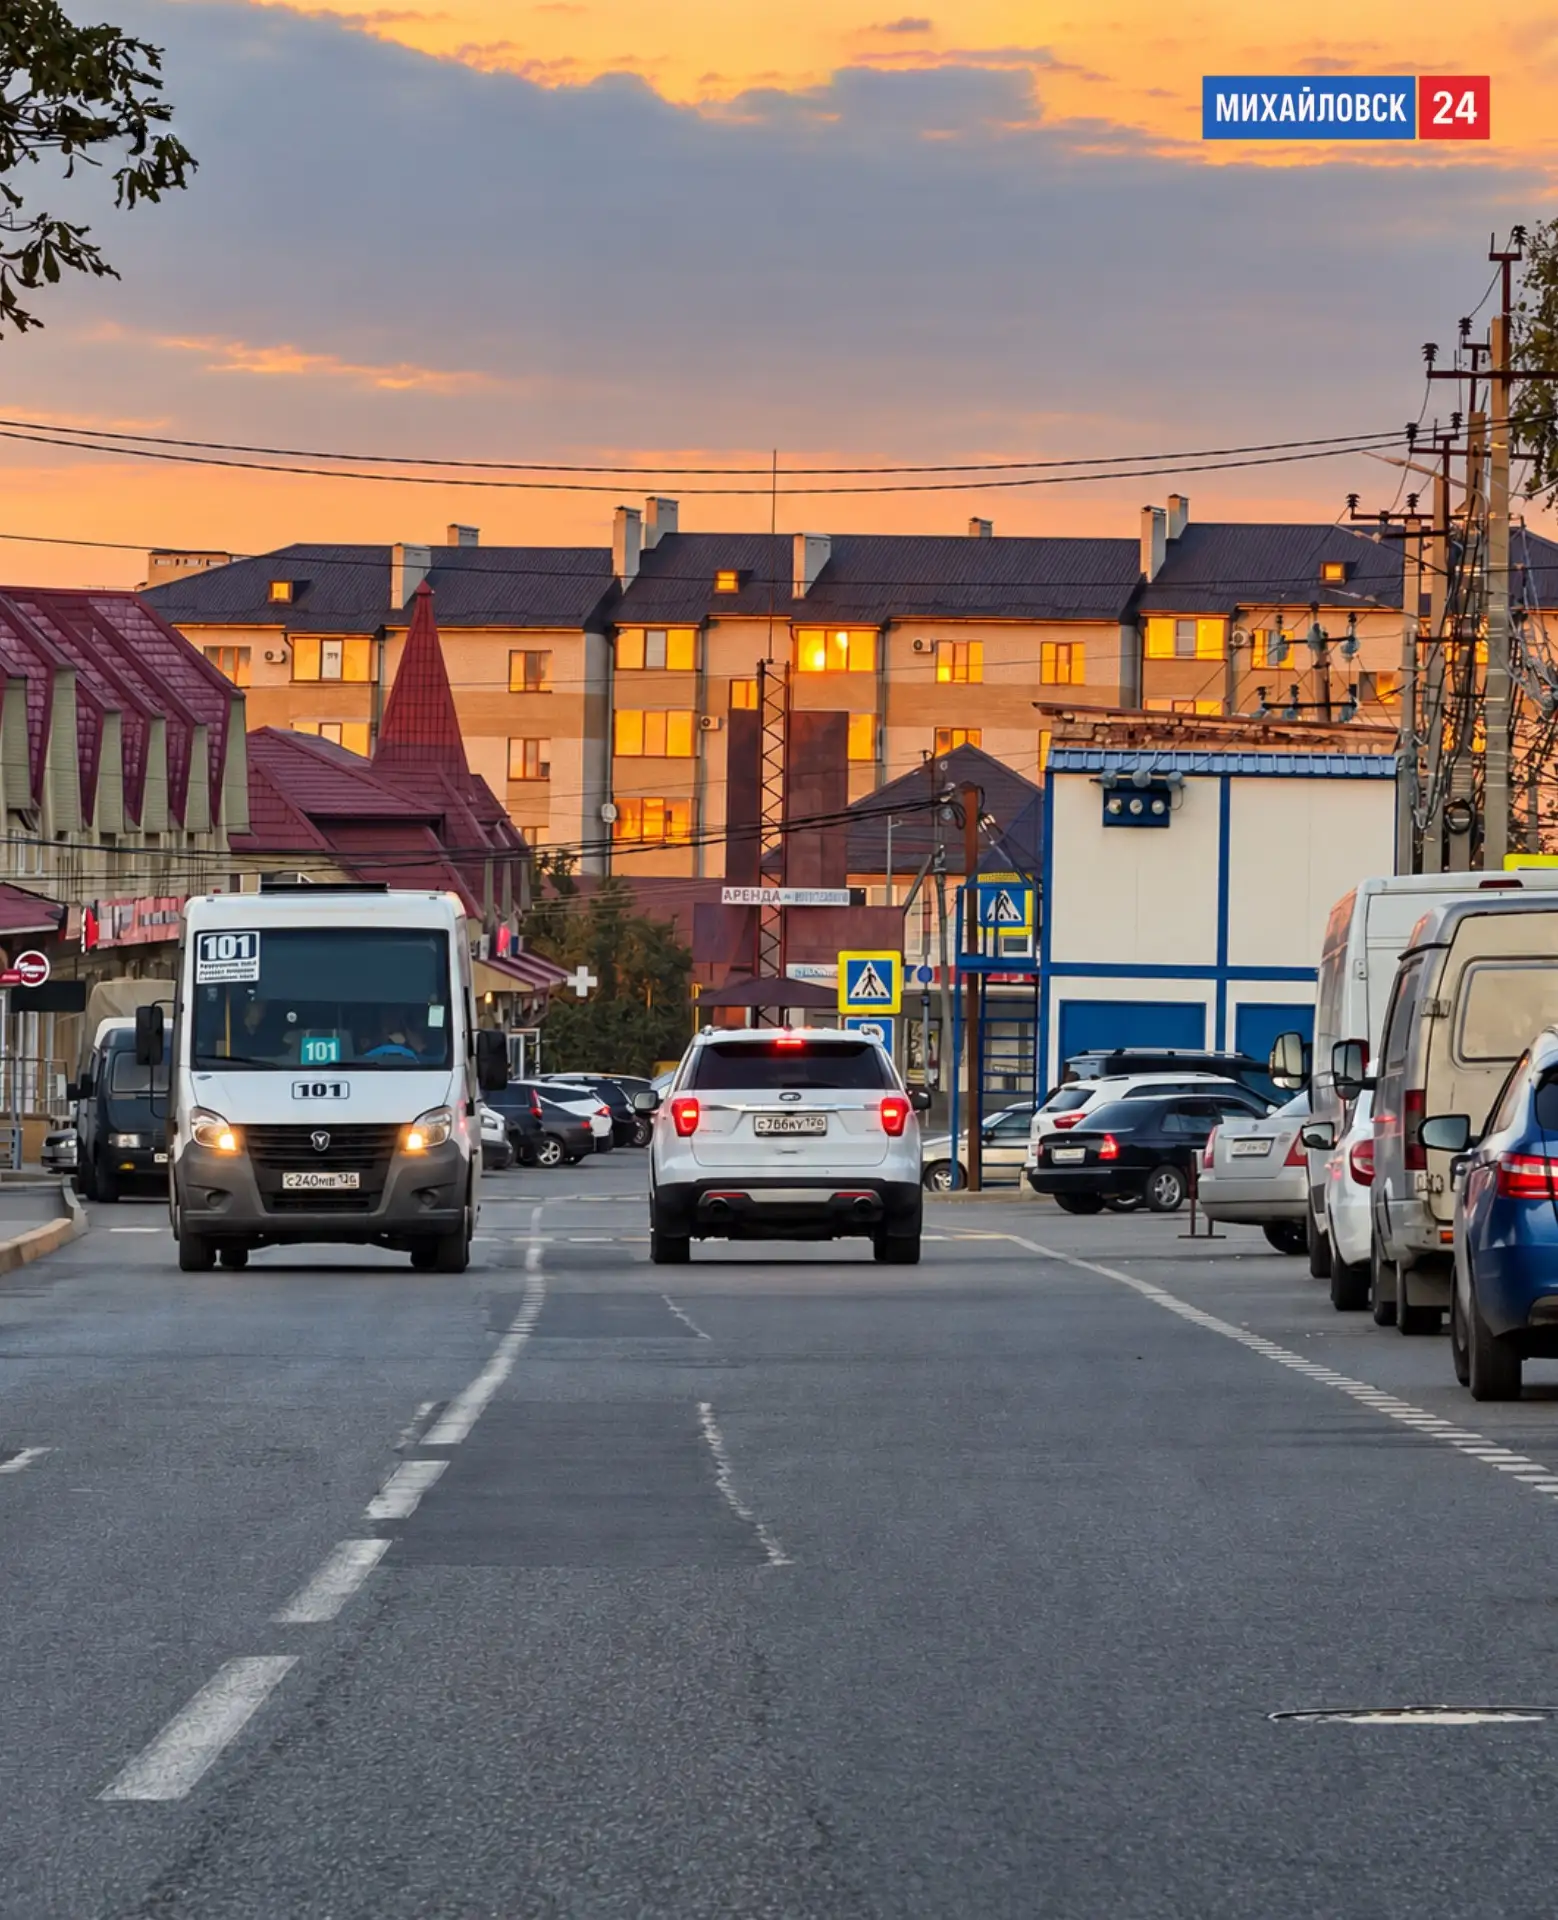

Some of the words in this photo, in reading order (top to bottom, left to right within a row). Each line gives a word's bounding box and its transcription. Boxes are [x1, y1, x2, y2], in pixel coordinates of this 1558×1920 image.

[724, 889, 781, 902] АРЕНДА
[203, 935, 250, 960] 101
[306, 1041, 337, 1061] 101
[298, 1083, 341, 1097] 101
